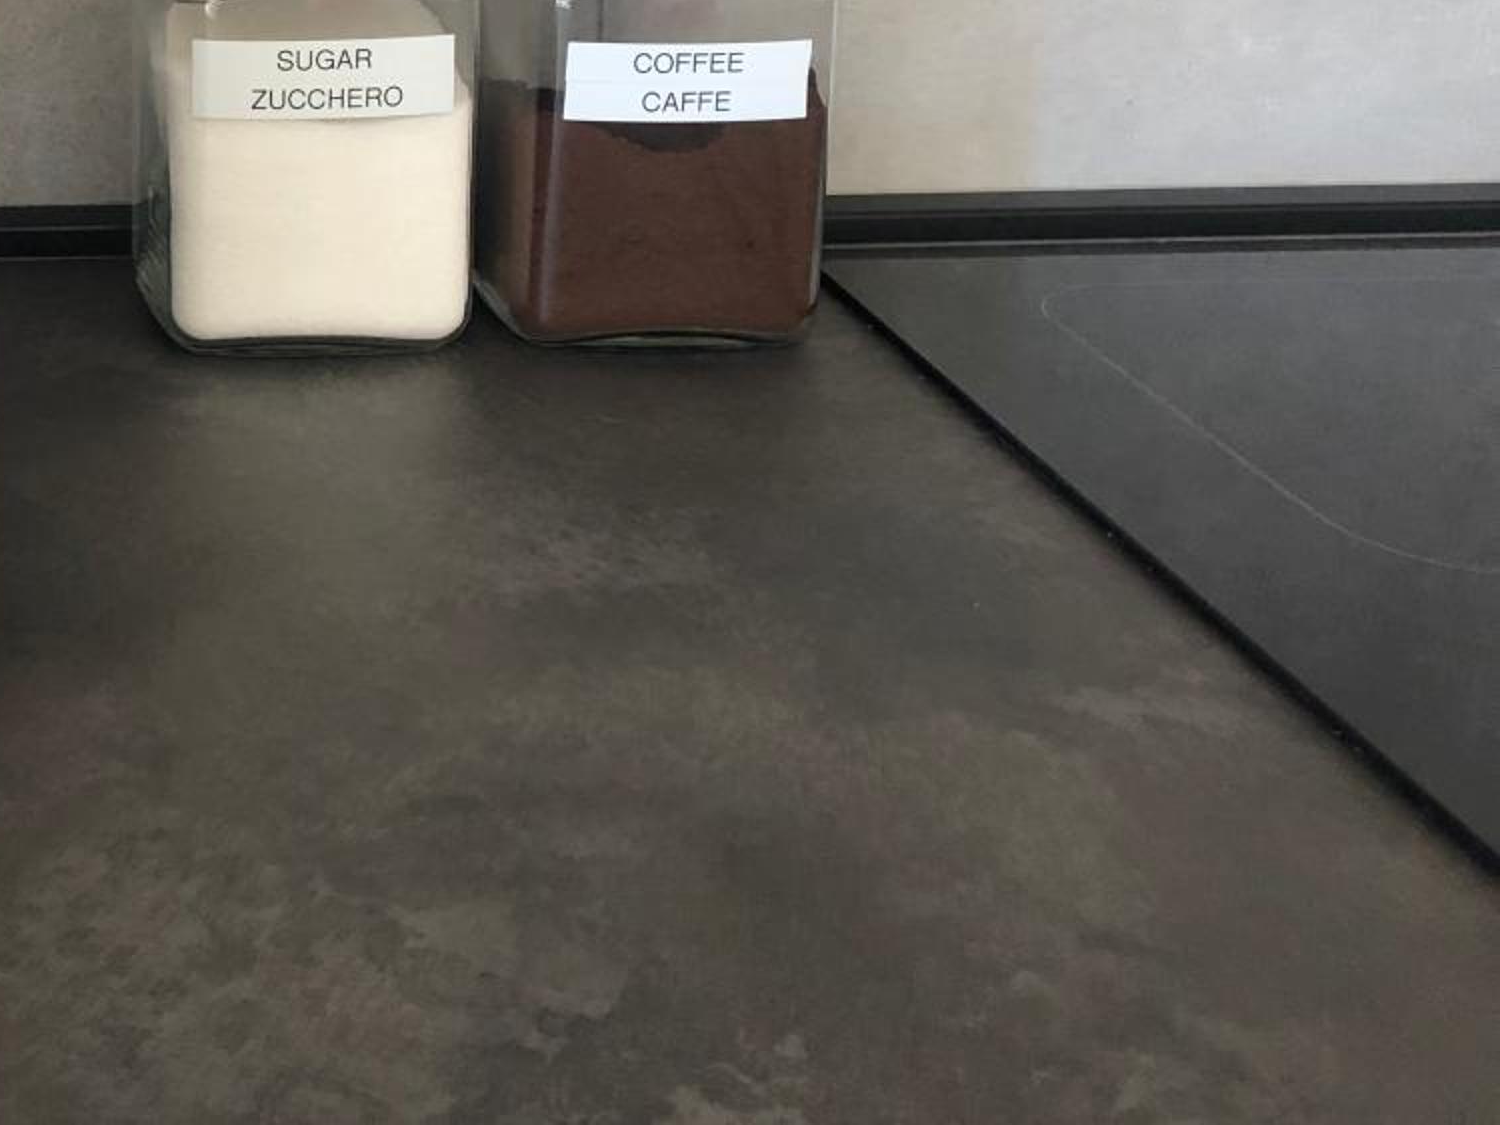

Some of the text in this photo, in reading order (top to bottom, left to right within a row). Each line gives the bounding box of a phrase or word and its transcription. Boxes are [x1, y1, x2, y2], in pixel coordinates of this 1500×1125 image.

[276, 48, 373, 72] SUGAR
[633, 52, 745, 74] COFFEE
[250, 85, 405, 111] ZUCCHERO
[641, 90, 732, 113] CAFFE
